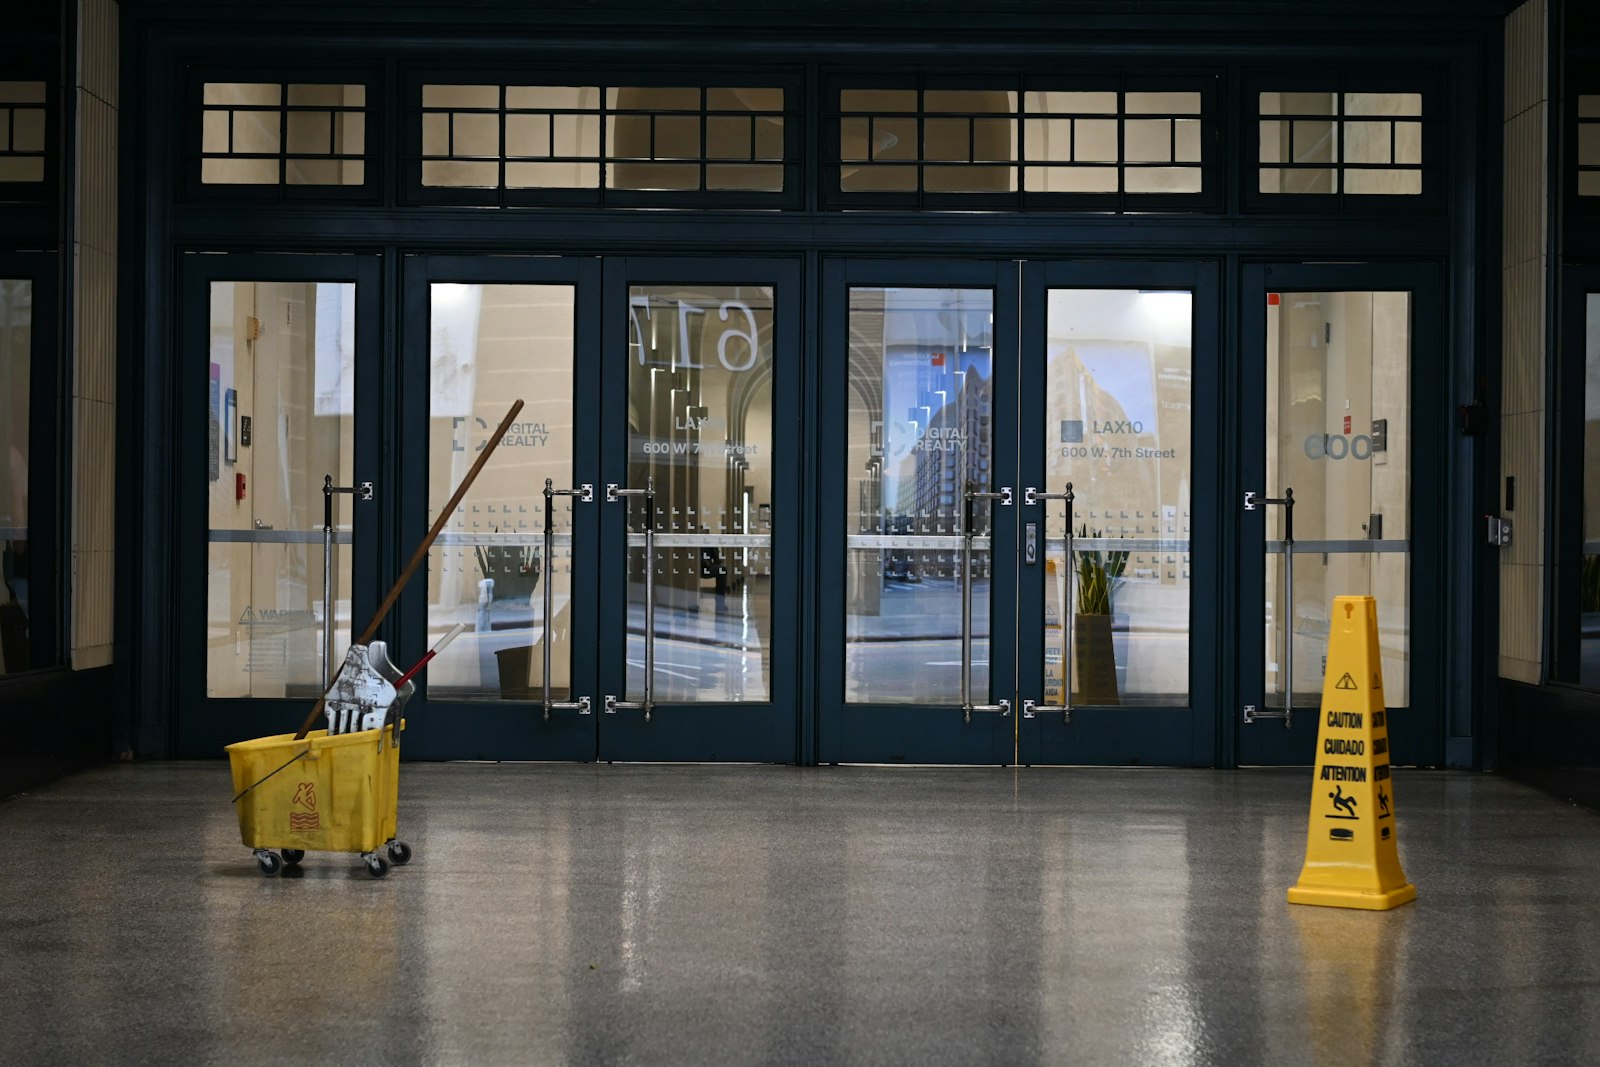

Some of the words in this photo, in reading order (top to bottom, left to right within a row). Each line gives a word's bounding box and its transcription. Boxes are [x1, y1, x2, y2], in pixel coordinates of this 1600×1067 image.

[496, 423, 549, 434] IGITAL
[915, 427, 968, 439] DIGITAL
[1093, 421, 1144, 434] LAX10
[643, 443, 669, 454] 600
[720, 443, 758, 454] treet
[915, 440, 967, 451] REALTY
[1304, 433, 1373, 460] 600
[1061, 447, 1087, 458] 600
[1091, 447, 1108, 458] W.
[1111, 447, 1132, 458] 7th
[1135, 447, 1176, 459] Street
[1327, 711, 1363, 729] CAUTION
[1324, 738, 1365, 756] CUIDADO
[1320, 765, 1367, 783] ATTENTION
